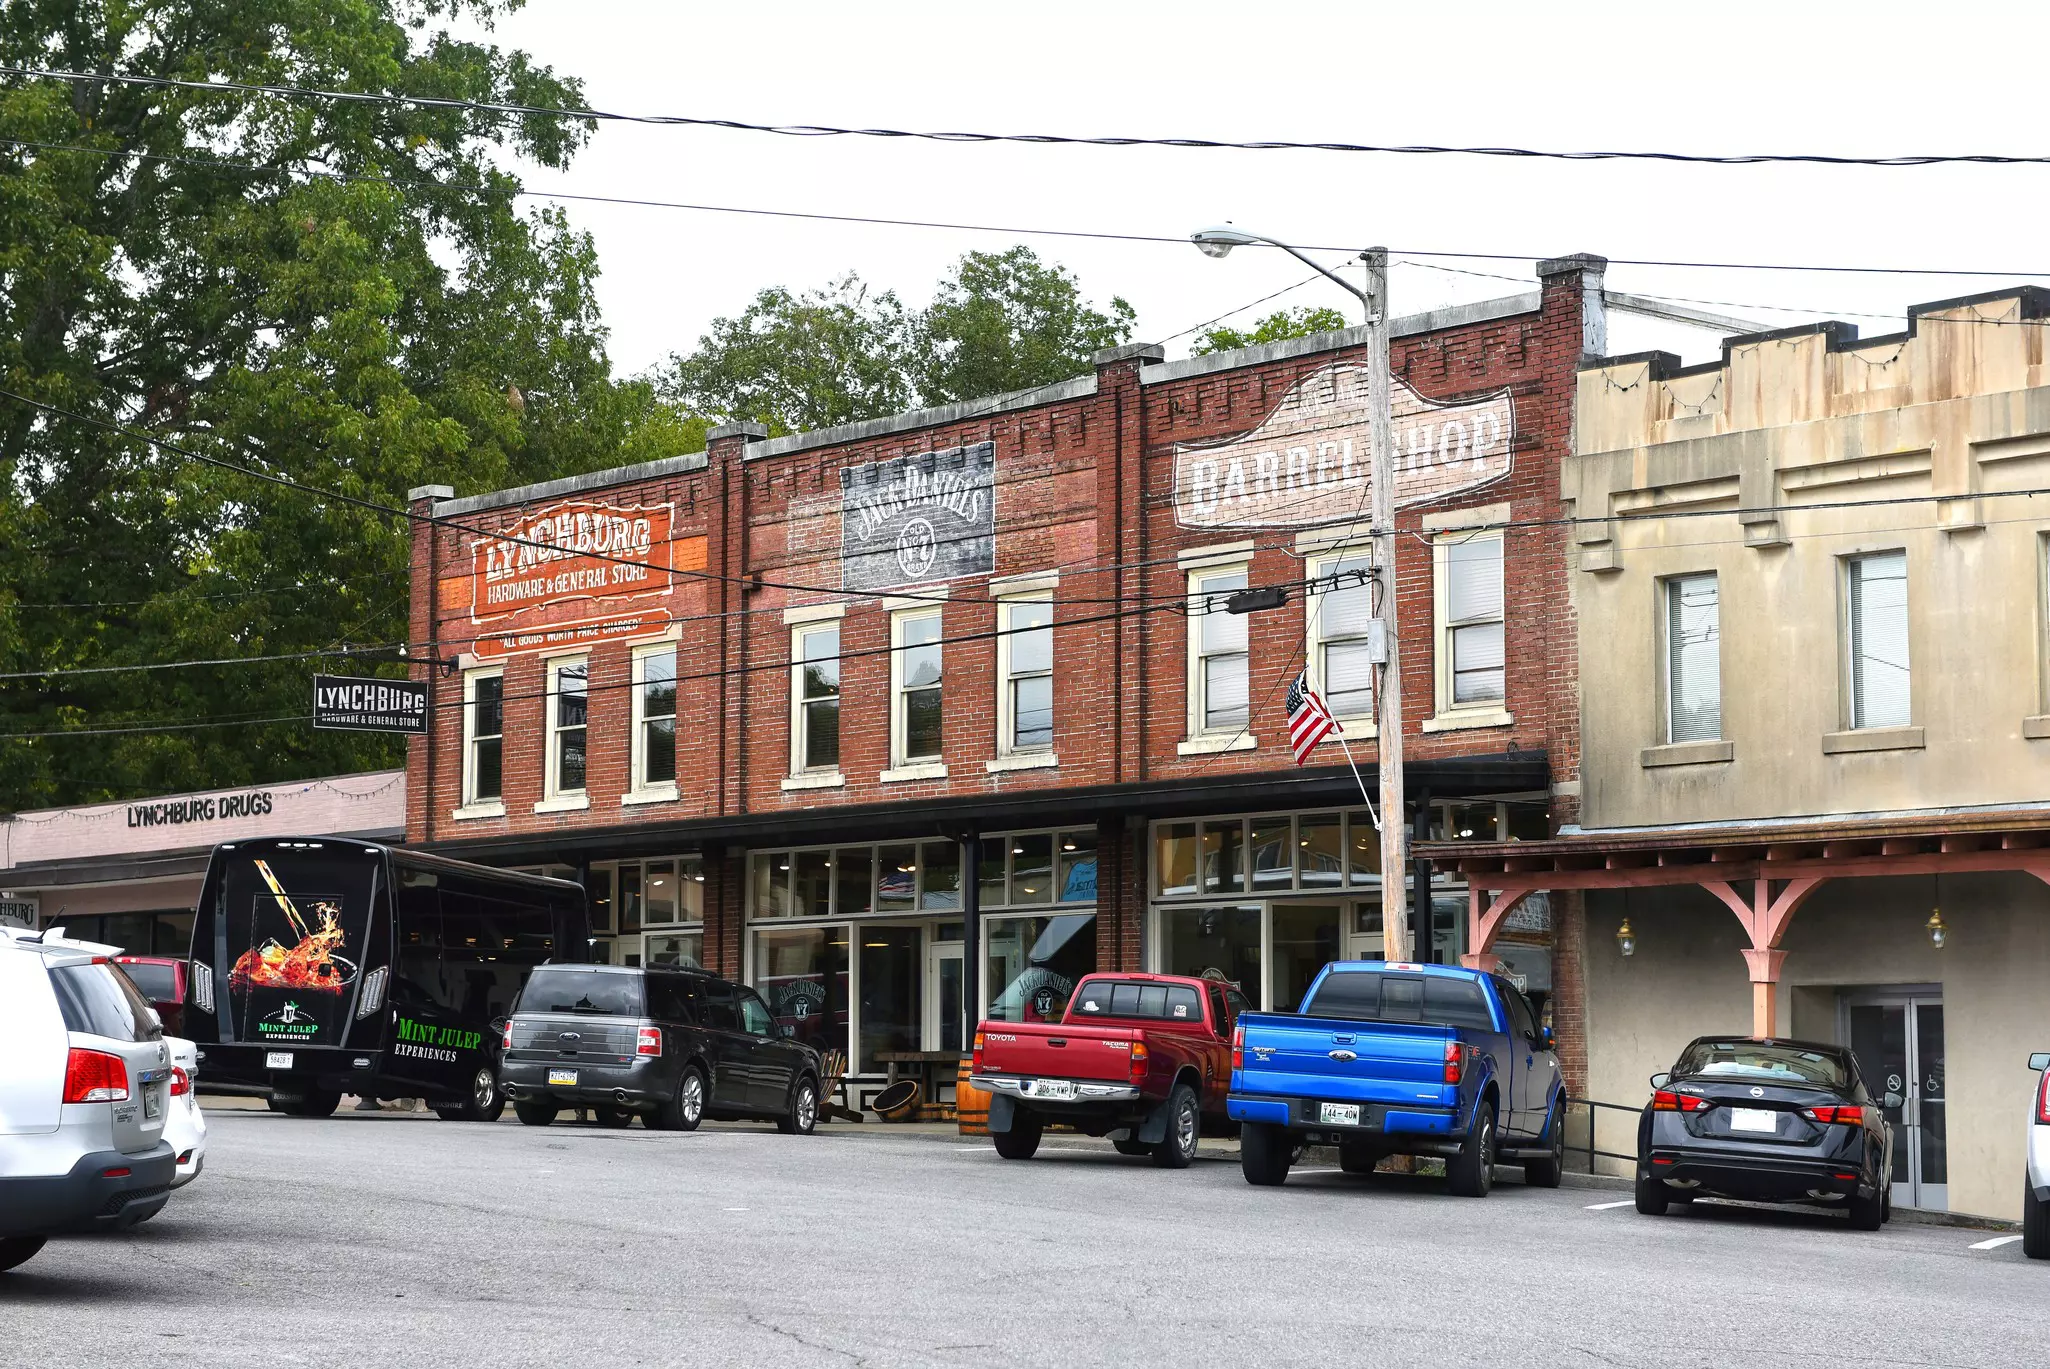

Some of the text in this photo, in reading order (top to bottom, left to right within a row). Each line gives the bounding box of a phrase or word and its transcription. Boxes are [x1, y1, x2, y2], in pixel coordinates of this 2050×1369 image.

[1191, 439, 1363, 515] BARREL
[856, 479, 904, 541] JACK
[910, 524, 926, 534] OLD
[485, 512, 652, 583] LYNCHBURG
[487, 560, 648, 604] HARDWARE & GENERAL STORE
[519, 634, 544, 646] GOODS
[547, 628, 574, 642] WORTH
[577, 624, 599, 638] PRICE
[318, 685, 425, 714] LYNCHBURG
[322, 712, 420, 728] HARDWARE & GENERAL STORE
[127, 791, 273, 828] LYNCHBURG DRUGS
[0, 902, 34, 926] HBURG
[258, 1022, 319, 1034] MINT JULEP
[397, 1018, 481, 1050] MINT JULEP
[986, 1033, 1017, 1042] TOYOTA
[394, 1043, 457, 1062] EXPERIENCES
